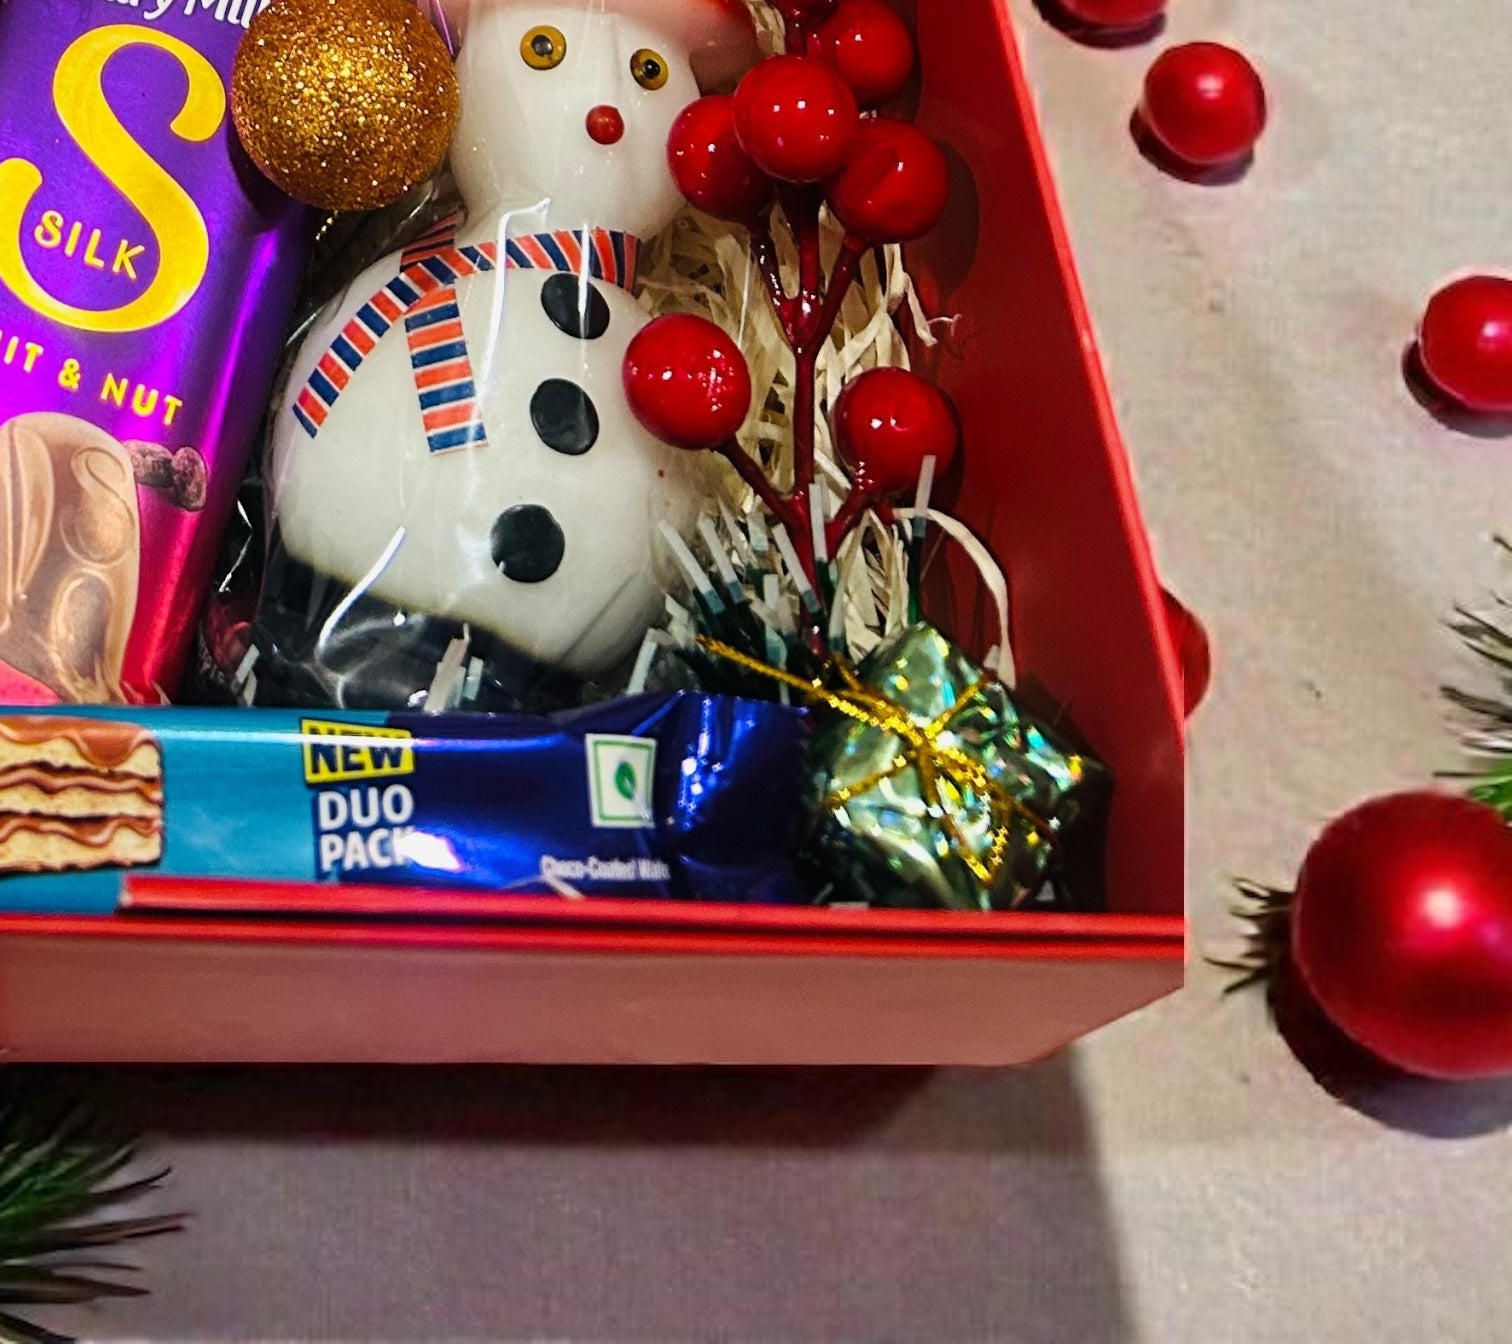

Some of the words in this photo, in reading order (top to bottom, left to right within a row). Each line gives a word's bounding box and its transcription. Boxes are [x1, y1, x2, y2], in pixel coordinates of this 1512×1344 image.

[34, 210, 145, 279] SILK
[58, 358, 81, 390] &
[100, 372, 183, 426] NUT
[308, 725, 407, 774] NEW
[318, 784, 414, 831] DUO
